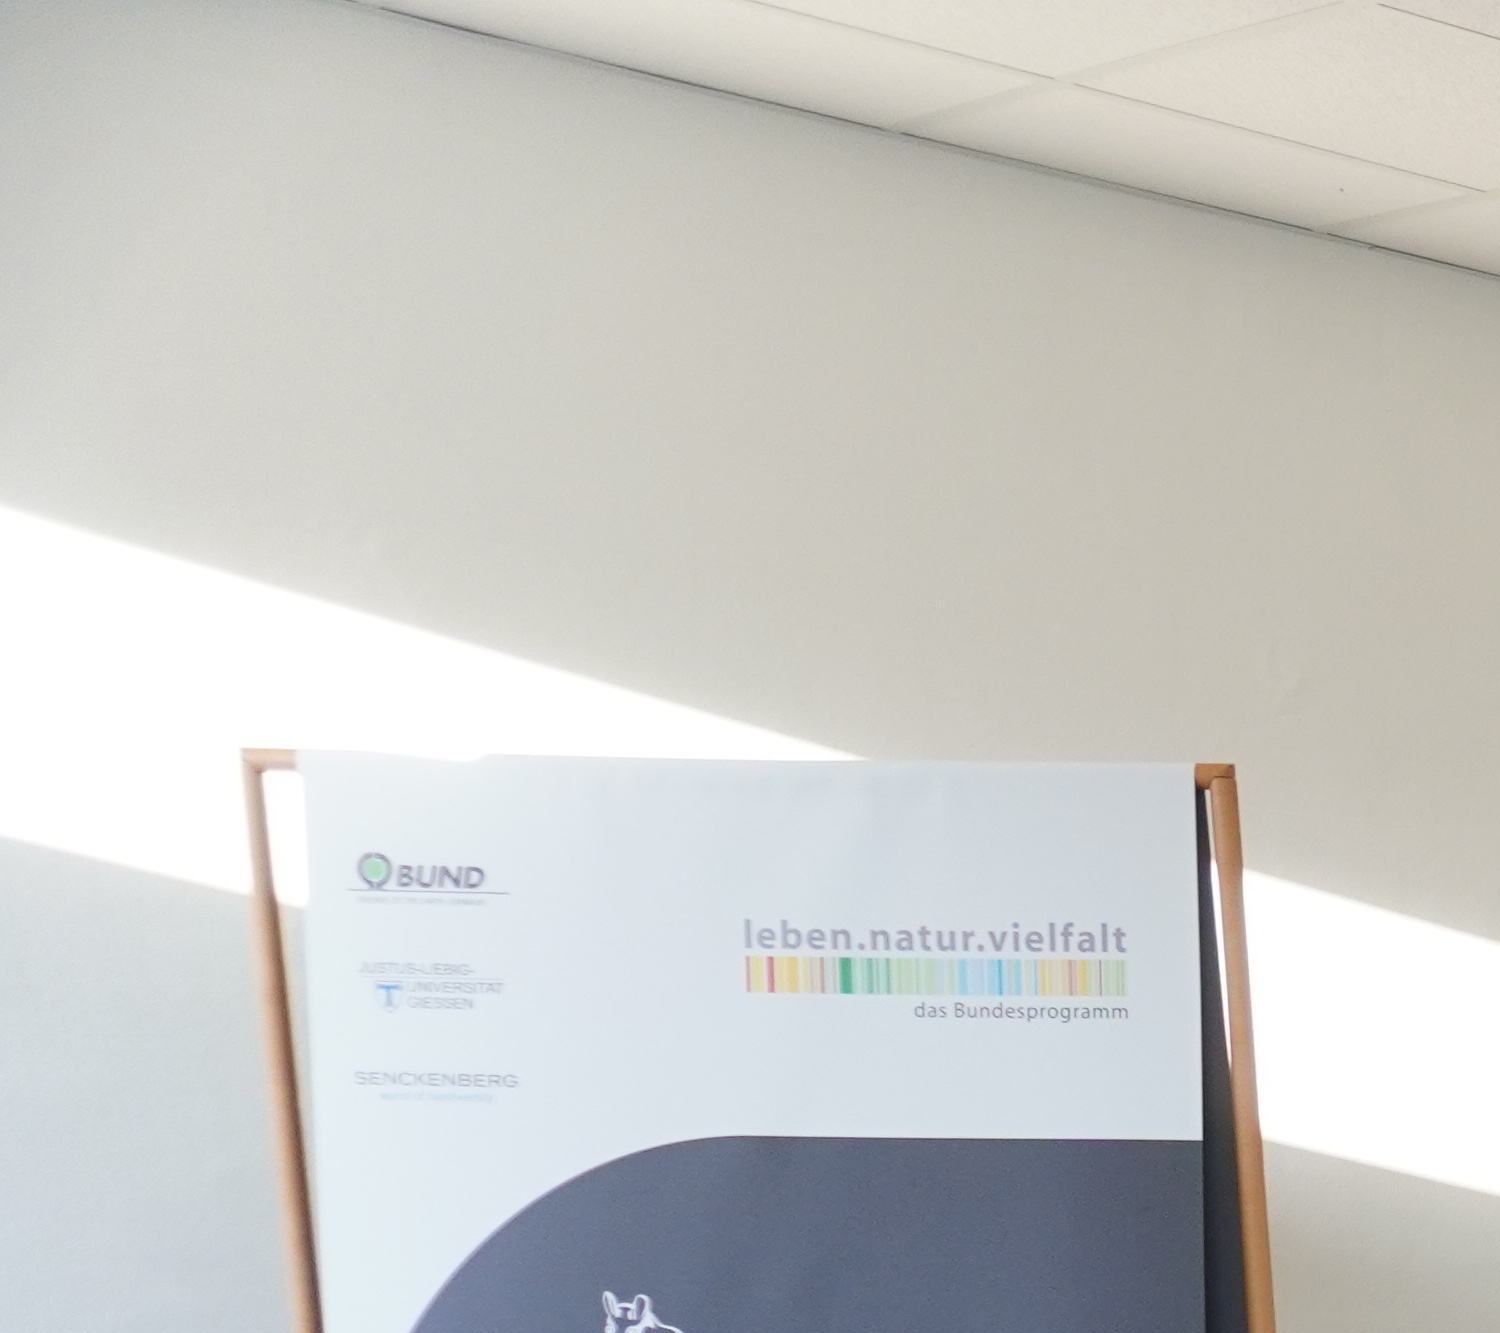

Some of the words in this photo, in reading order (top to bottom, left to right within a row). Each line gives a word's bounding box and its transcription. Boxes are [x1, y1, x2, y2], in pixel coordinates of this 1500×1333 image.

[396, 865, 486, 889] BUND
[743, 918, 1128, 954] leben.natur.vielfalt
[406, 997, 474, 1009] GIESSEN
[914, 1002, 947, 1020] das
[954, 1001, 1130, 1024] Bundesprogramm
[354, 1071, 518, 1088] SENCKENBERG
